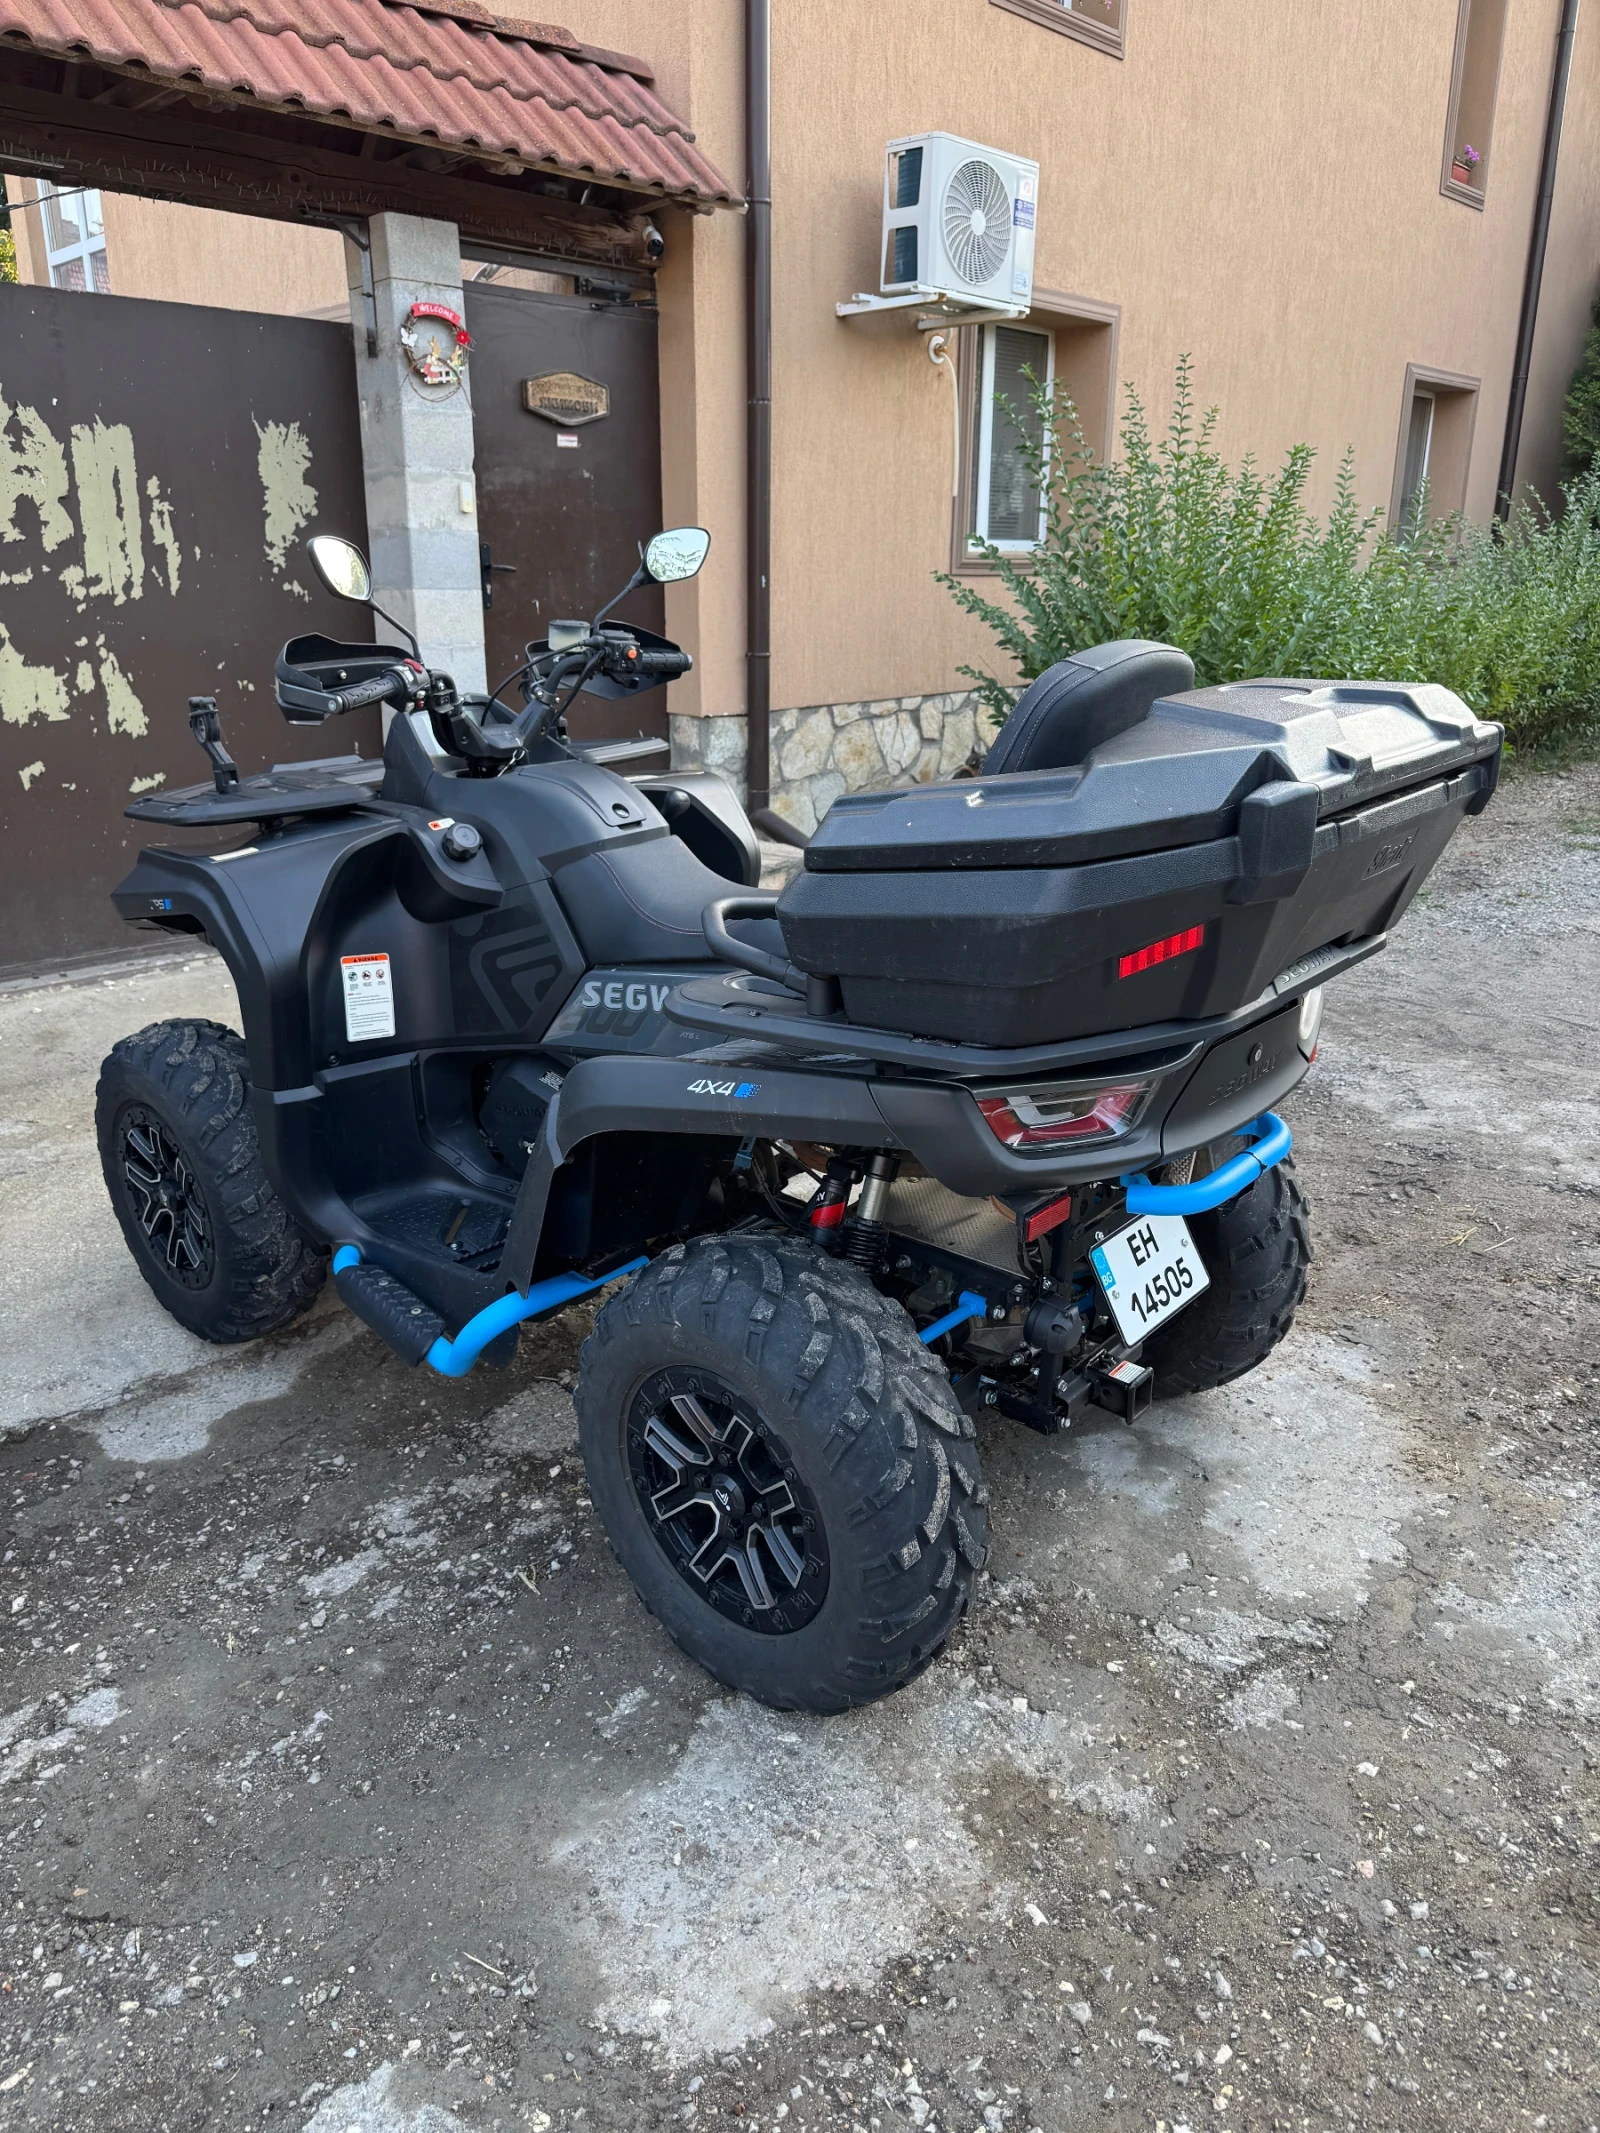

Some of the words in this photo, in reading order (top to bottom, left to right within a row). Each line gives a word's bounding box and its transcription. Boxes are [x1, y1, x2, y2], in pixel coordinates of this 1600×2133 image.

[418, 303, 454, 320] WELCOME
[1279, 945, 1336, 984] SEGWAY
[580, 980, 670, 1013] SEGW
[1126, 1222, 1160, 1267] EH
[1101, 1271, 1113, 1286] BG
[1131, 1256, 1194, 1323] 14505
